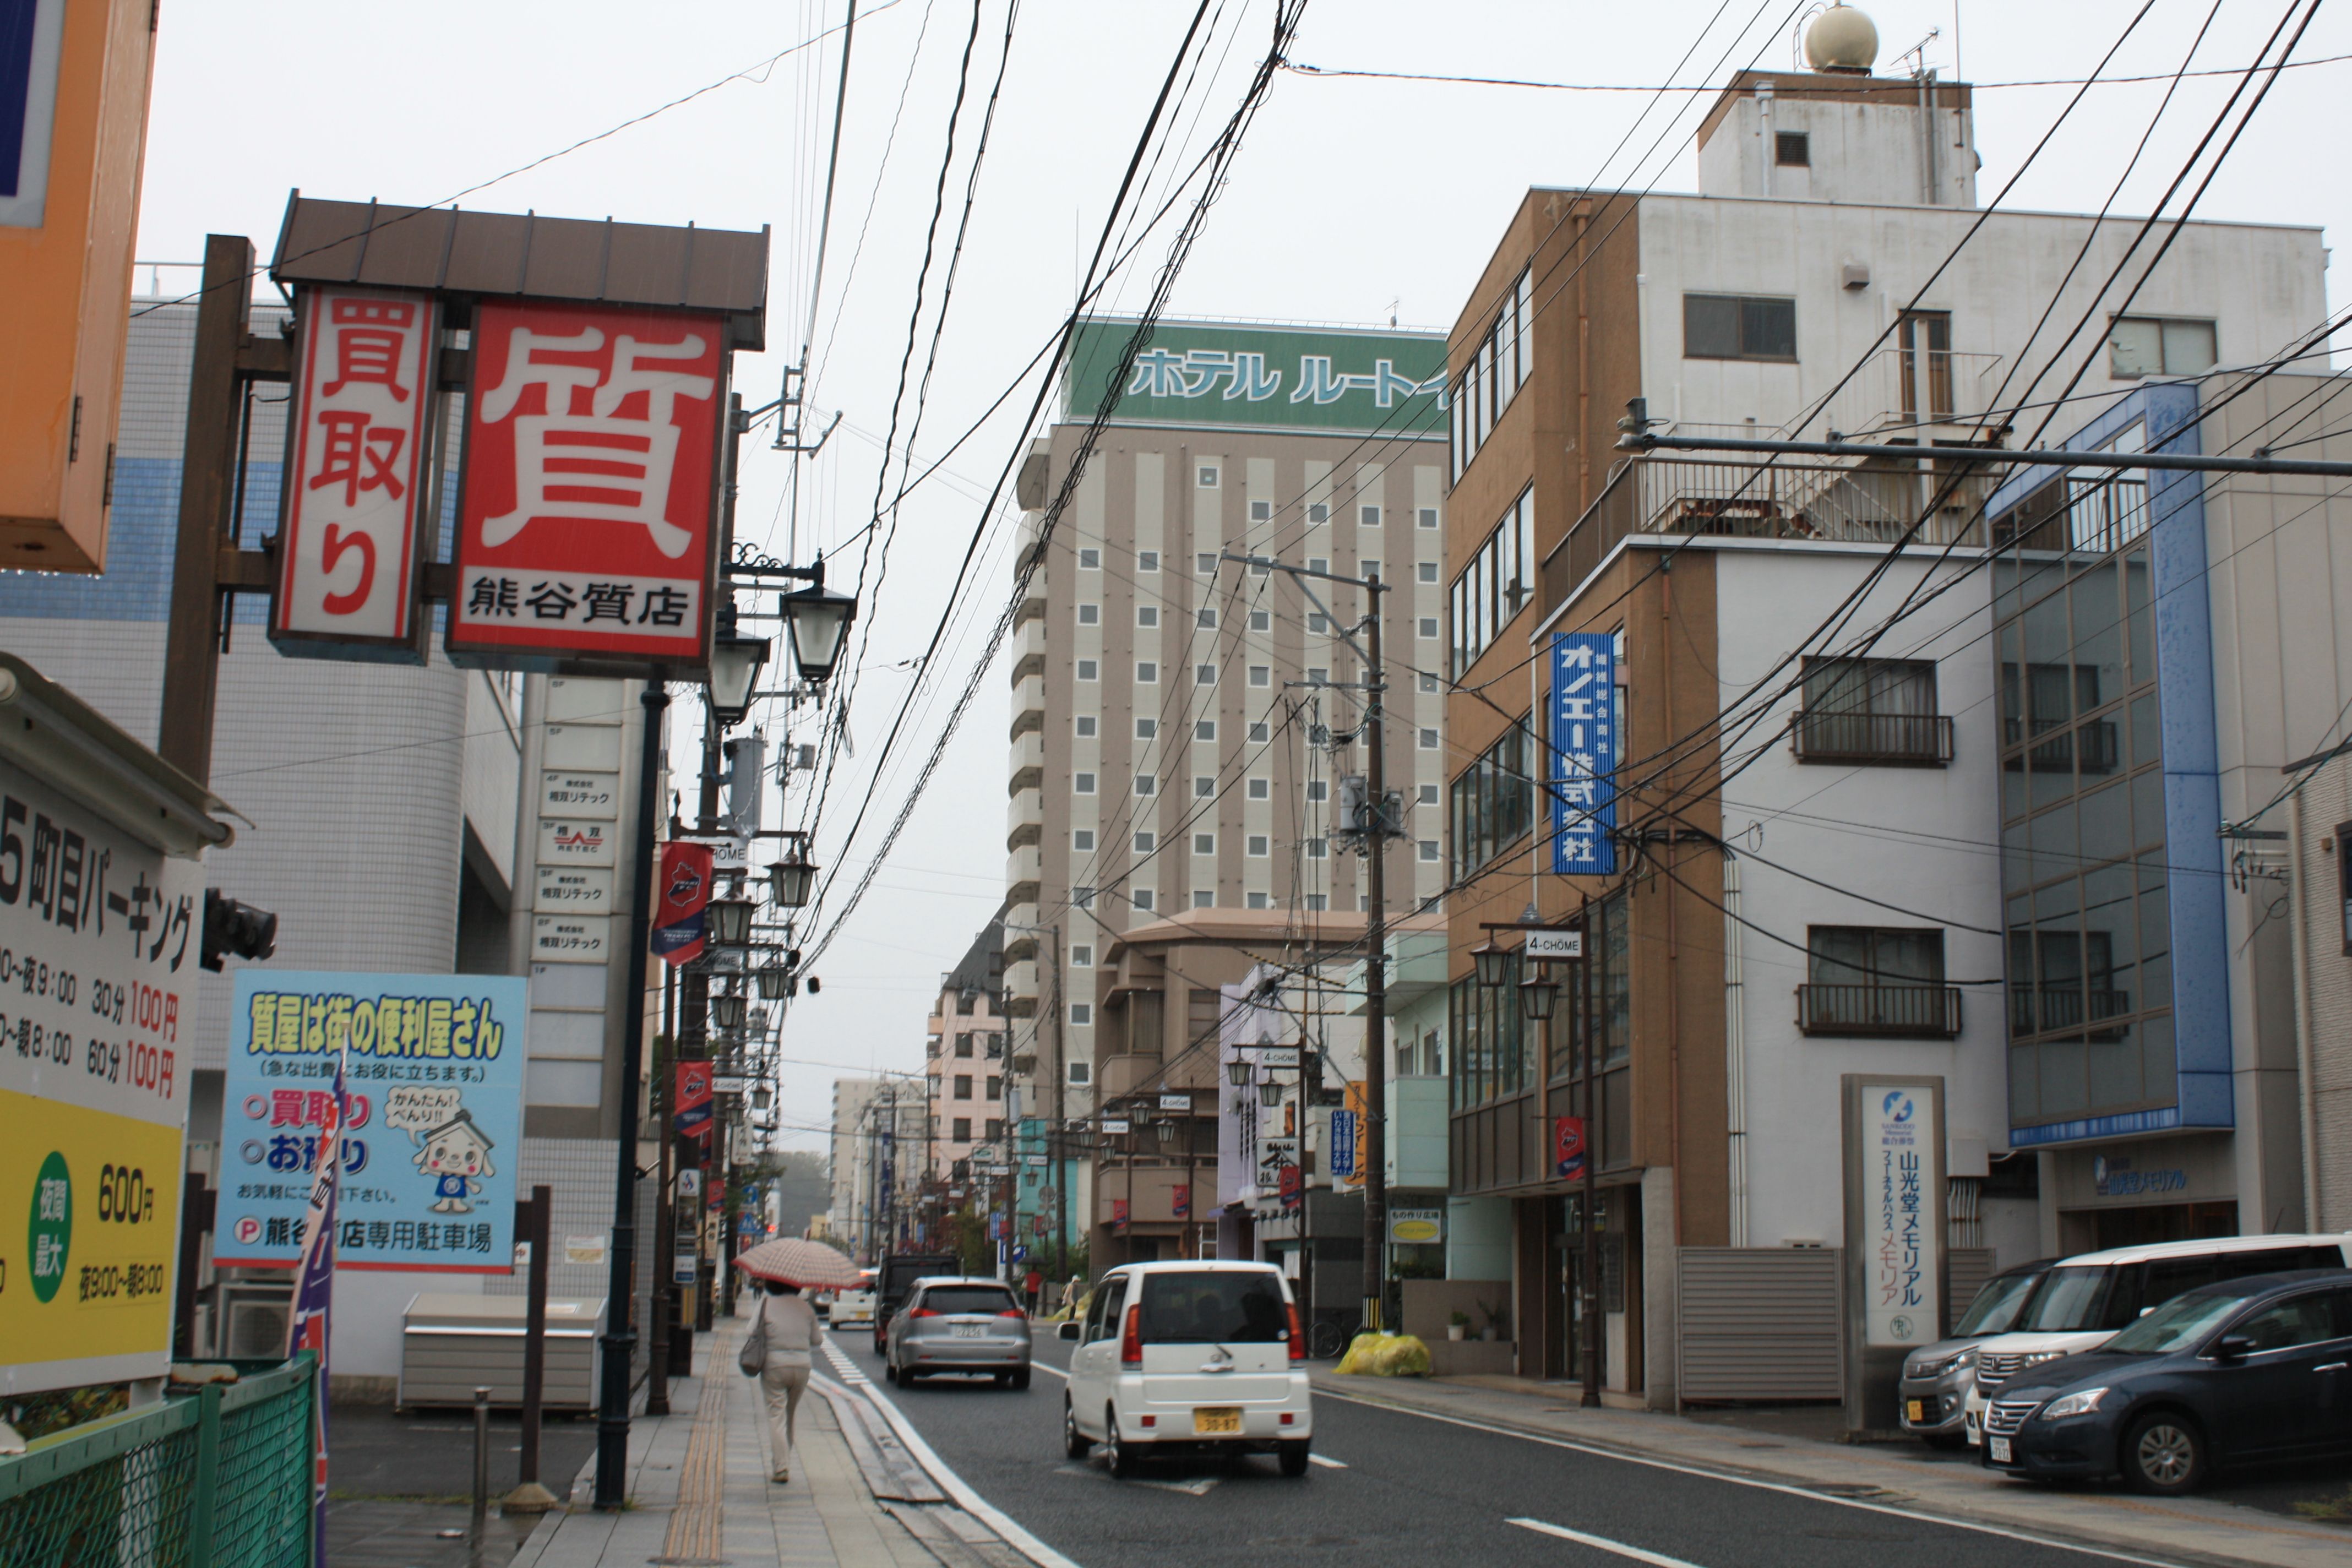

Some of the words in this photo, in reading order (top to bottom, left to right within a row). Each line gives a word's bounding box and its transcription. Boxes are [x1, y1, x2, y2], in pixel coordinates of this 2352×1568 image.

[1128, 349, 1282, 402] ホテル
[309, 298, 416, 615] 買取り
[480, 326, 715, 559] 質
[469, 576, 689, 627] 熊谷質店
[549, 791, 609, 803] 相双リテック
[0, 795, 193, 973] 5町目パーキング
[542, 888, 602, 900] 相双リテック
[540, 937, 601, 949] 相双リテック
[556, 925, 585, 934] 株式会社
[92, 978, 124, 1026] 30分
[131, 980, 179, 1043] 100円
[248, 992, 503, 1060] 質屋は街の便利屋さん
[88, 1038, 121, 1084] 60分
[127, 1040, 174, 1100] 100円
[270, 1090, 372, 1130] 買取り
[98, 1163, 154, 1225] 600円
[237, 1185, 396, 1204] お気軽にご下さい。
[1882, 1150, 1894, 1231] フューネラルハウス
[265, 1217, 492, 1254] 熊谷店専用駐車場
[1899, 1151, 1921, 1306] 山光堂メモリアル
[1880, 1232, 1898, 1306] メモリア
